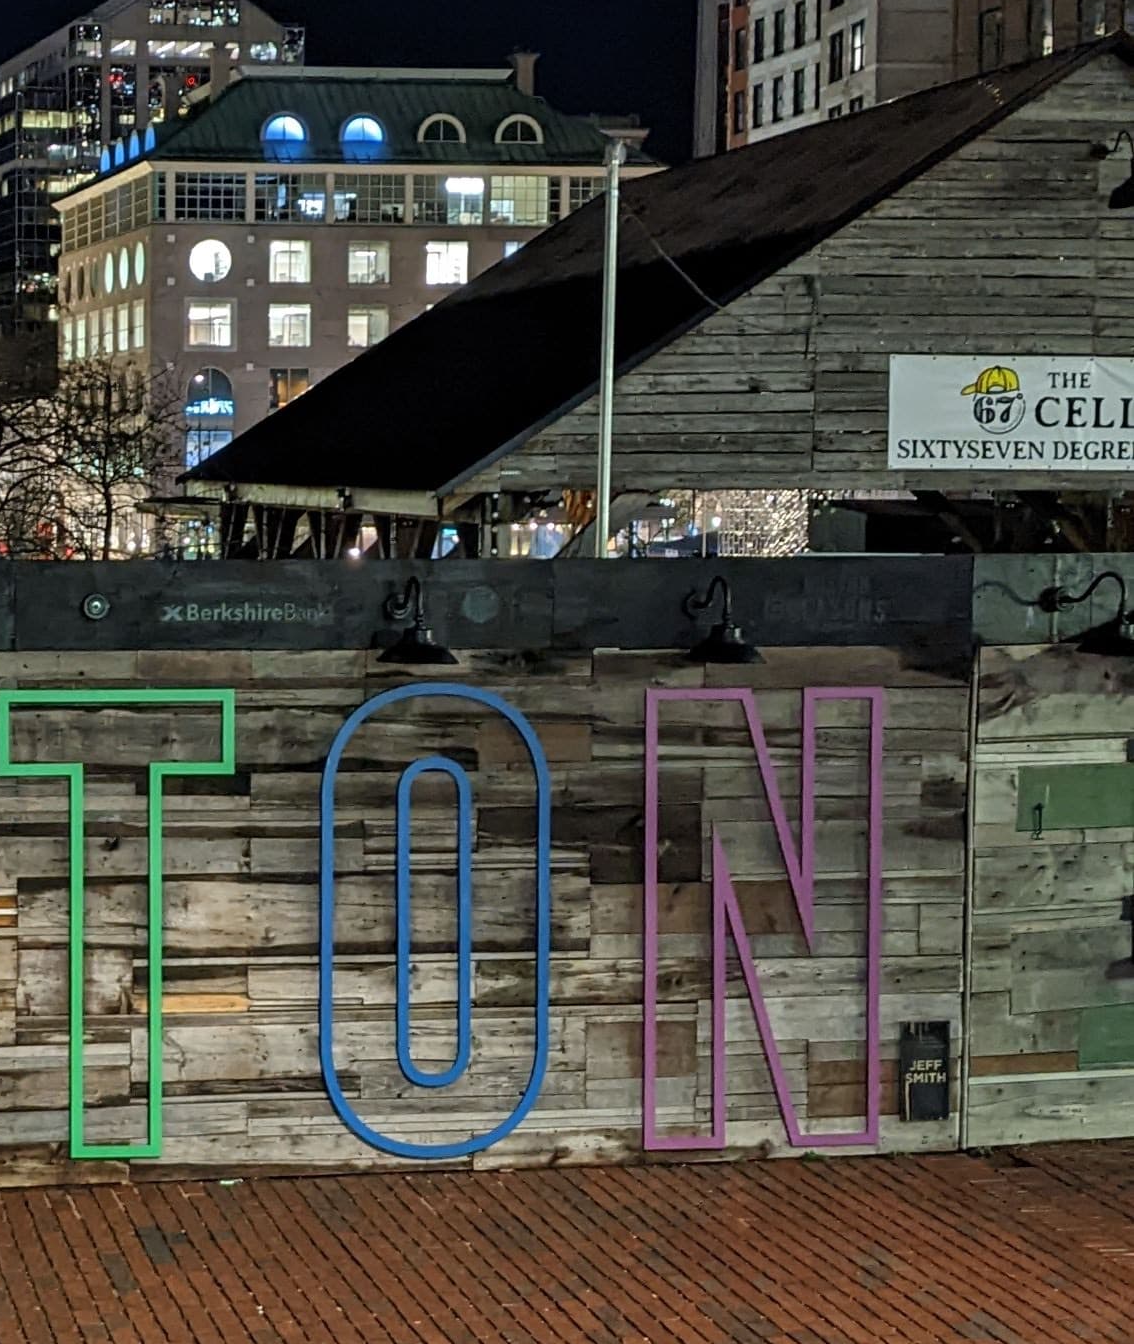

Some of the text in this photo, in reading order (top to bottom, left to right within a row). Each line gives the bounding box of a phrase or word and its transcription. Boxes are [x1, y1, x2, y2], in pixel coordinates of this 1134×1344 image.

[1047, 371, 1091, 389] THE
[1035, 396, 1134, 428] CELL
[897, 439, 1134, 460] SIXTYSEVEN DEGRE
[909, 1060, 942, 1070] JEFF
[905, 1072, 946, 1083] SMITH
